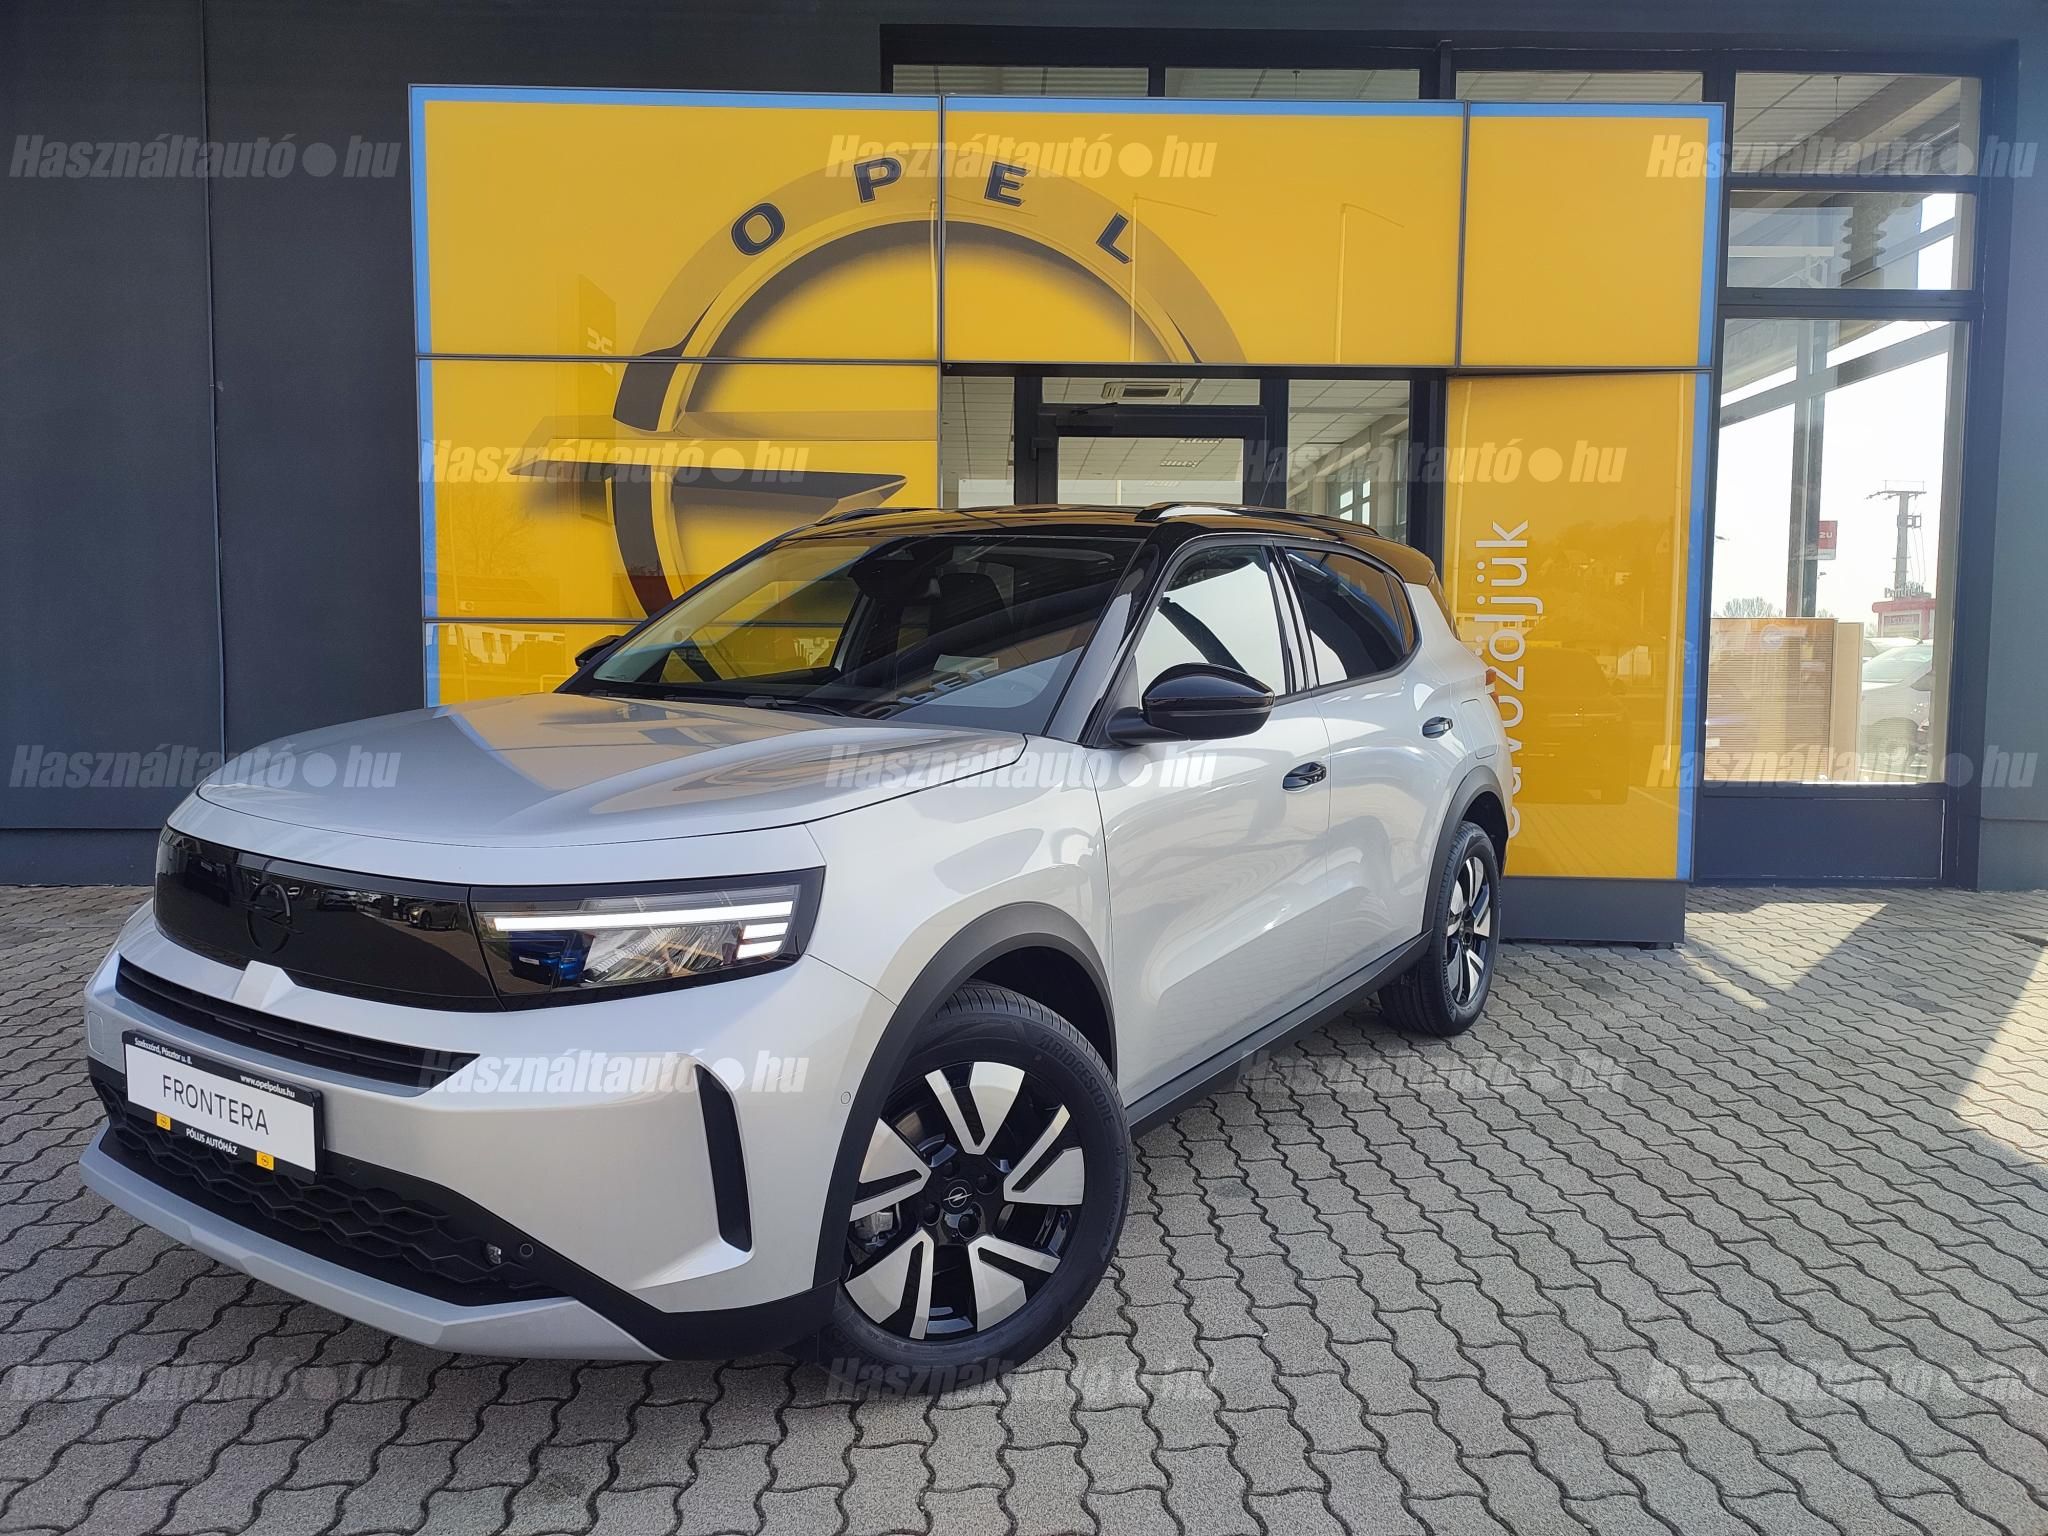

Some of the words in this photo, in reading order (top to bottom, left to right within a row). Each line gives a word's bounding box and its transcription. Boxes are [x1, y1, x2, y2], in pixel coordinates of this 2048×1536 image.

[730, 156, 1133, 264] OPEL
[162, 1074, 270, 1136] FRONTERA
[239, 1074, 296, 1098] www.opelpolus.hu
[1036, 1033, 1116, 1128] BRIDGESTONE
[185, 1127, 206, 1143] PÓLUS
[205, 1135, 238, 1156] AUTÓHÁZ
